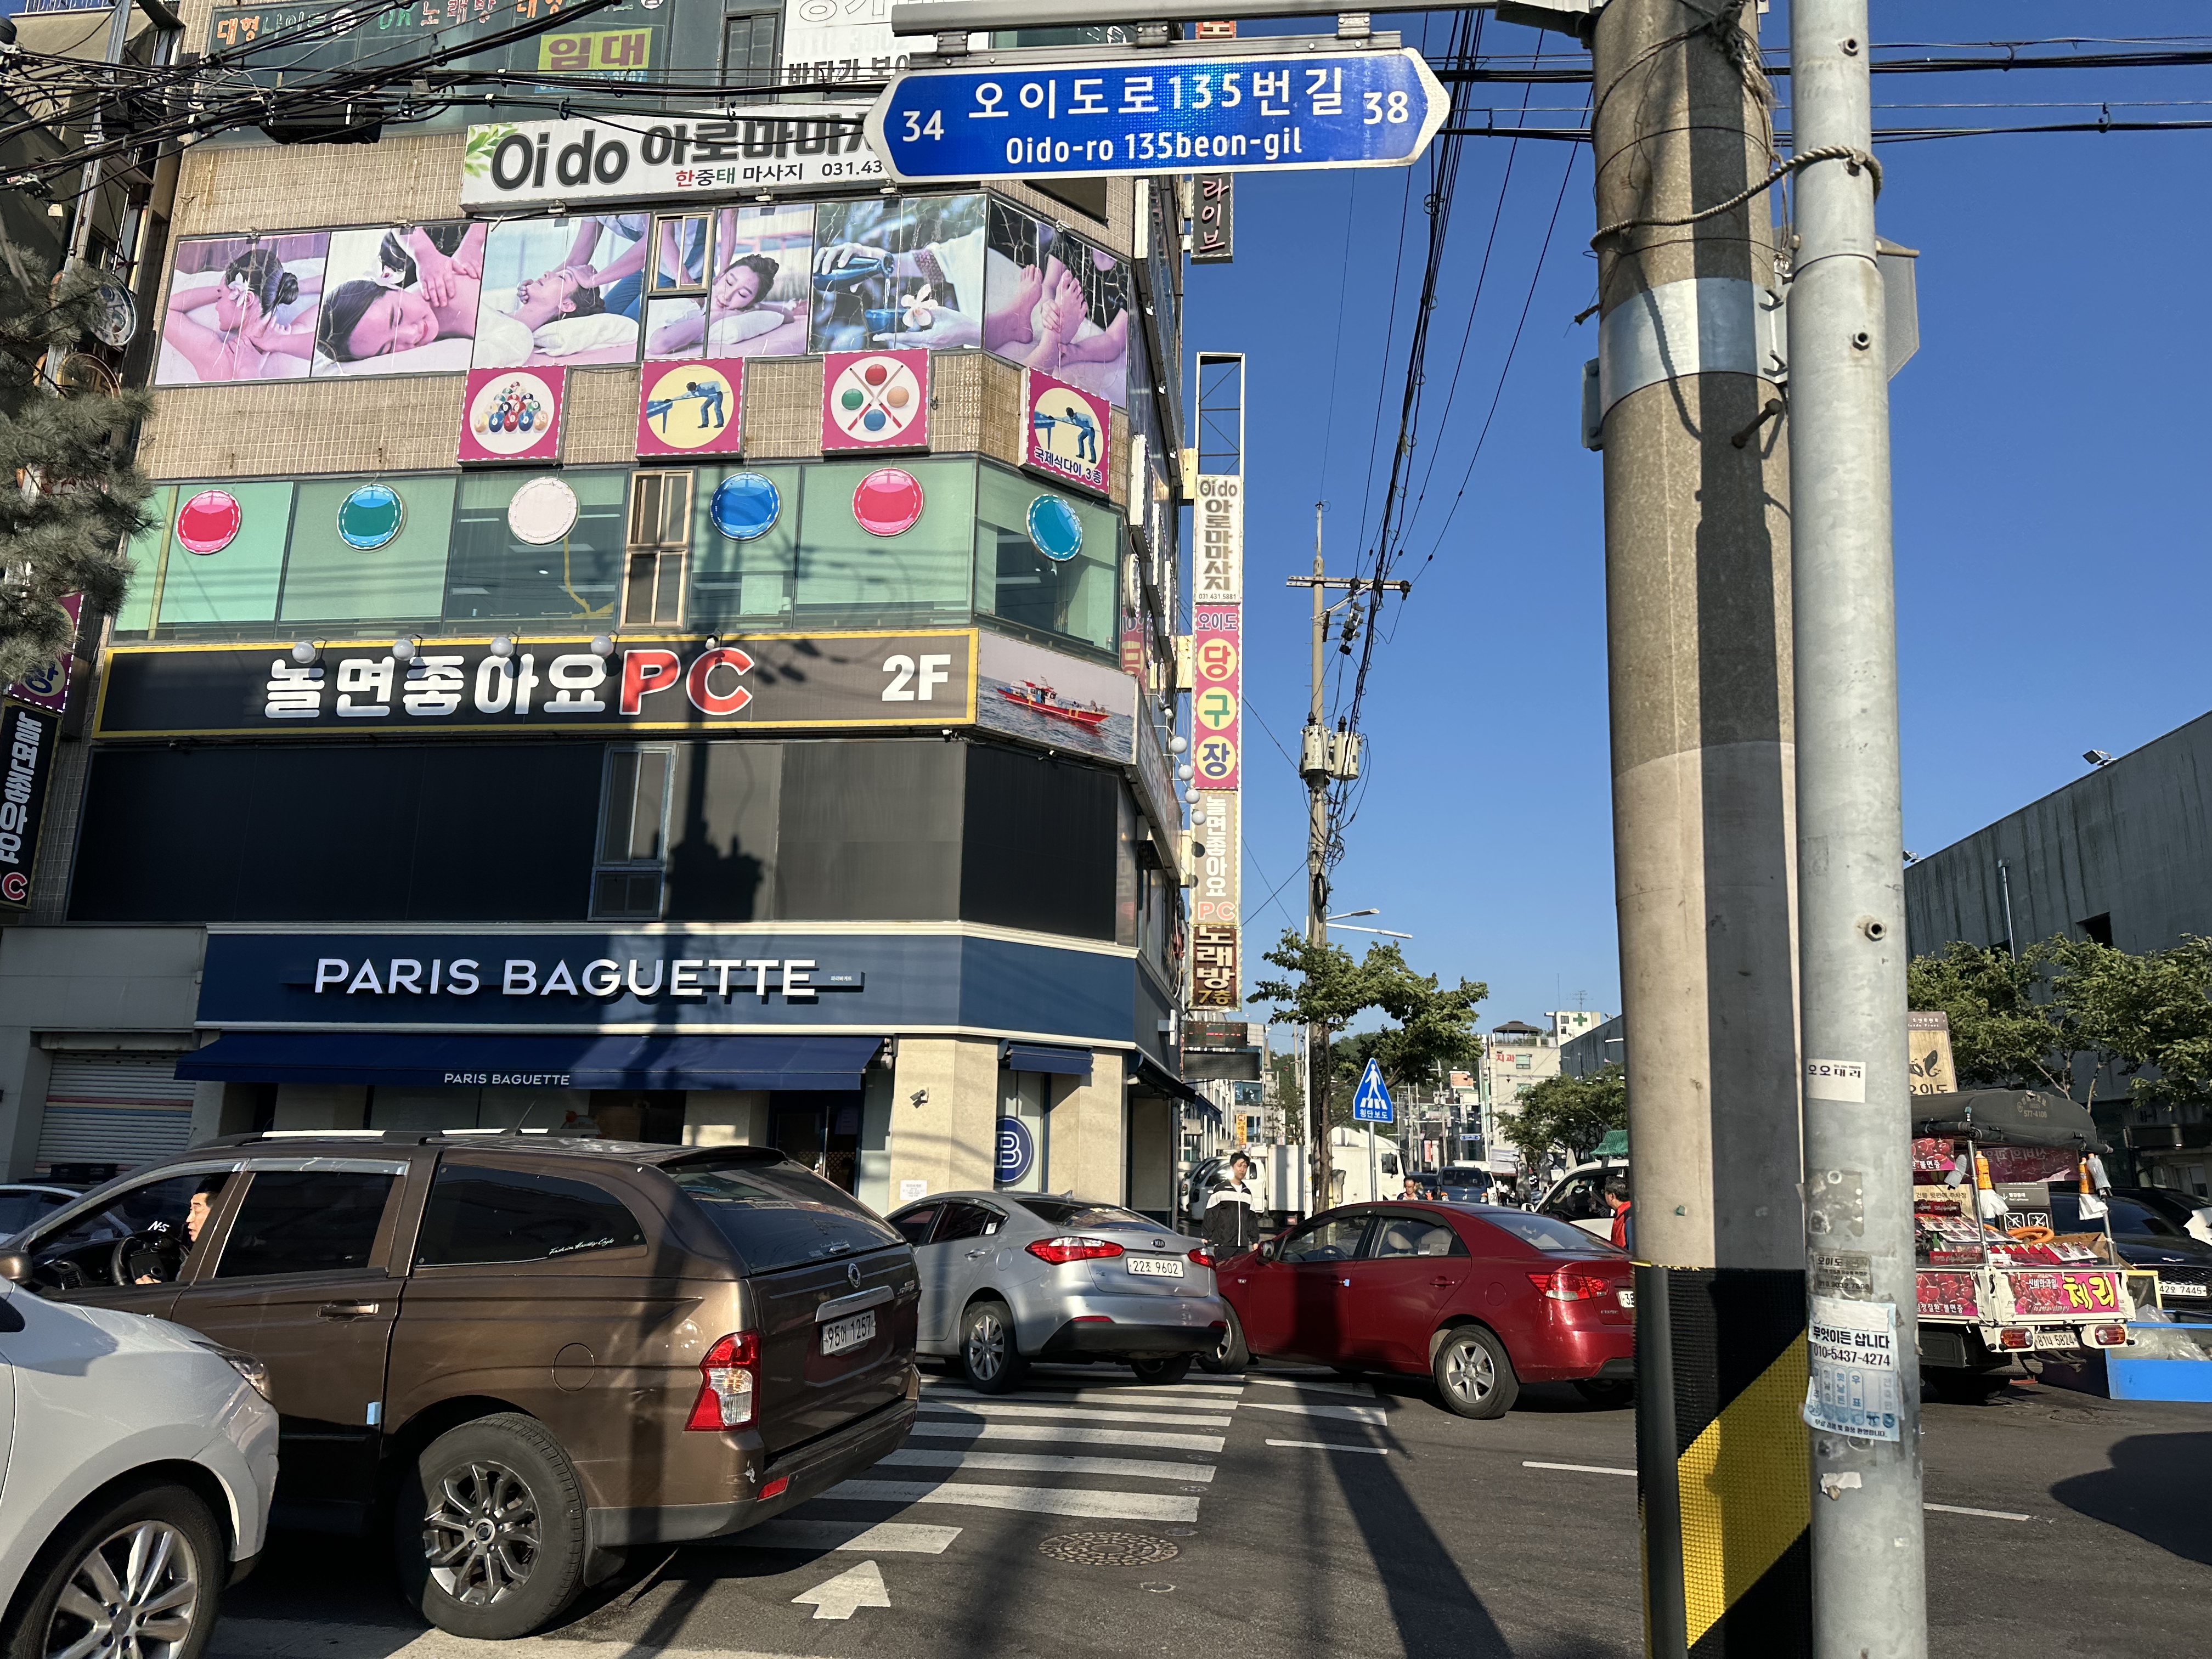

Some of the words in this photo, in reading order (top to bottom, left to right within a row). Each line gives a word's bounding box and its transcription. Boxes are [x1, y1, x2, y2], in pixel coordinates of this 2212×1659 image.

[421, 0, 496, 26] 노래방
[549, 34, 646, 70] 임대
[968, 68, 1343, 121] 오이도로135번길
[1363, 91, 1408, 125] 38
[901, 110, 944, 143] 34
[490, 128, 630, 192] Oido
[1006, 136, 1113, 165] Oido-ro
[1126, 127, 1303, 161] 135beon-gil
[675, 168, 735, 188] 한중태
[743, 163, 804, 183] 마사지
[1201, 179, 1229, 252] 라이브
[1035, 446, 1082, 477] 국제식다이
[1086, 467, 1102, 484] 3층
[1200, 480, 1238, 497] Oido
[1203, 499, 1233, 591] 아로마마사지
[1198, 612, 1238, 631] 오이도
[881, 653, 951, 702] 2F
[1203, 645, 1232, 778] 당구장
[1206, 796, 1228, 897] 놀면좋아요
[1198, 901, 1236, 921] PC
[1195, 926, 1235, 989] 노래방
[314, 958, 479, 996] PARIS
[502, 958, 816, 997] BAGUETTE
[1198, 990, 1232, 1005] 7층
[444, 1074, 489, 1085] PARIS
[492, 1074, 571, 1086] BAGUETTE
[1360, 1108, 1389, 1119] 횡단보도
[1133, 1260, 1152, 1272] 22조
[1155, 1262, 1178, 1274] 9602
[2062, 1276, 2114, 1311] 체리
[2159, 1285, 2176, 1293] 42오
[2180, 1286, 2202, 1295] 7445
[828, 1324, 847, 1349] 95어
[850, 1314, 871, 1341] 1257
[1813, 1325, 1852, 1345] 무엇이든
[1854, 1333, 1890, 1349] 삽니다
[2054, 1334, 2075, 1346] 5824
[1813, 1344, 1891, 1367] 010-5437-4274
